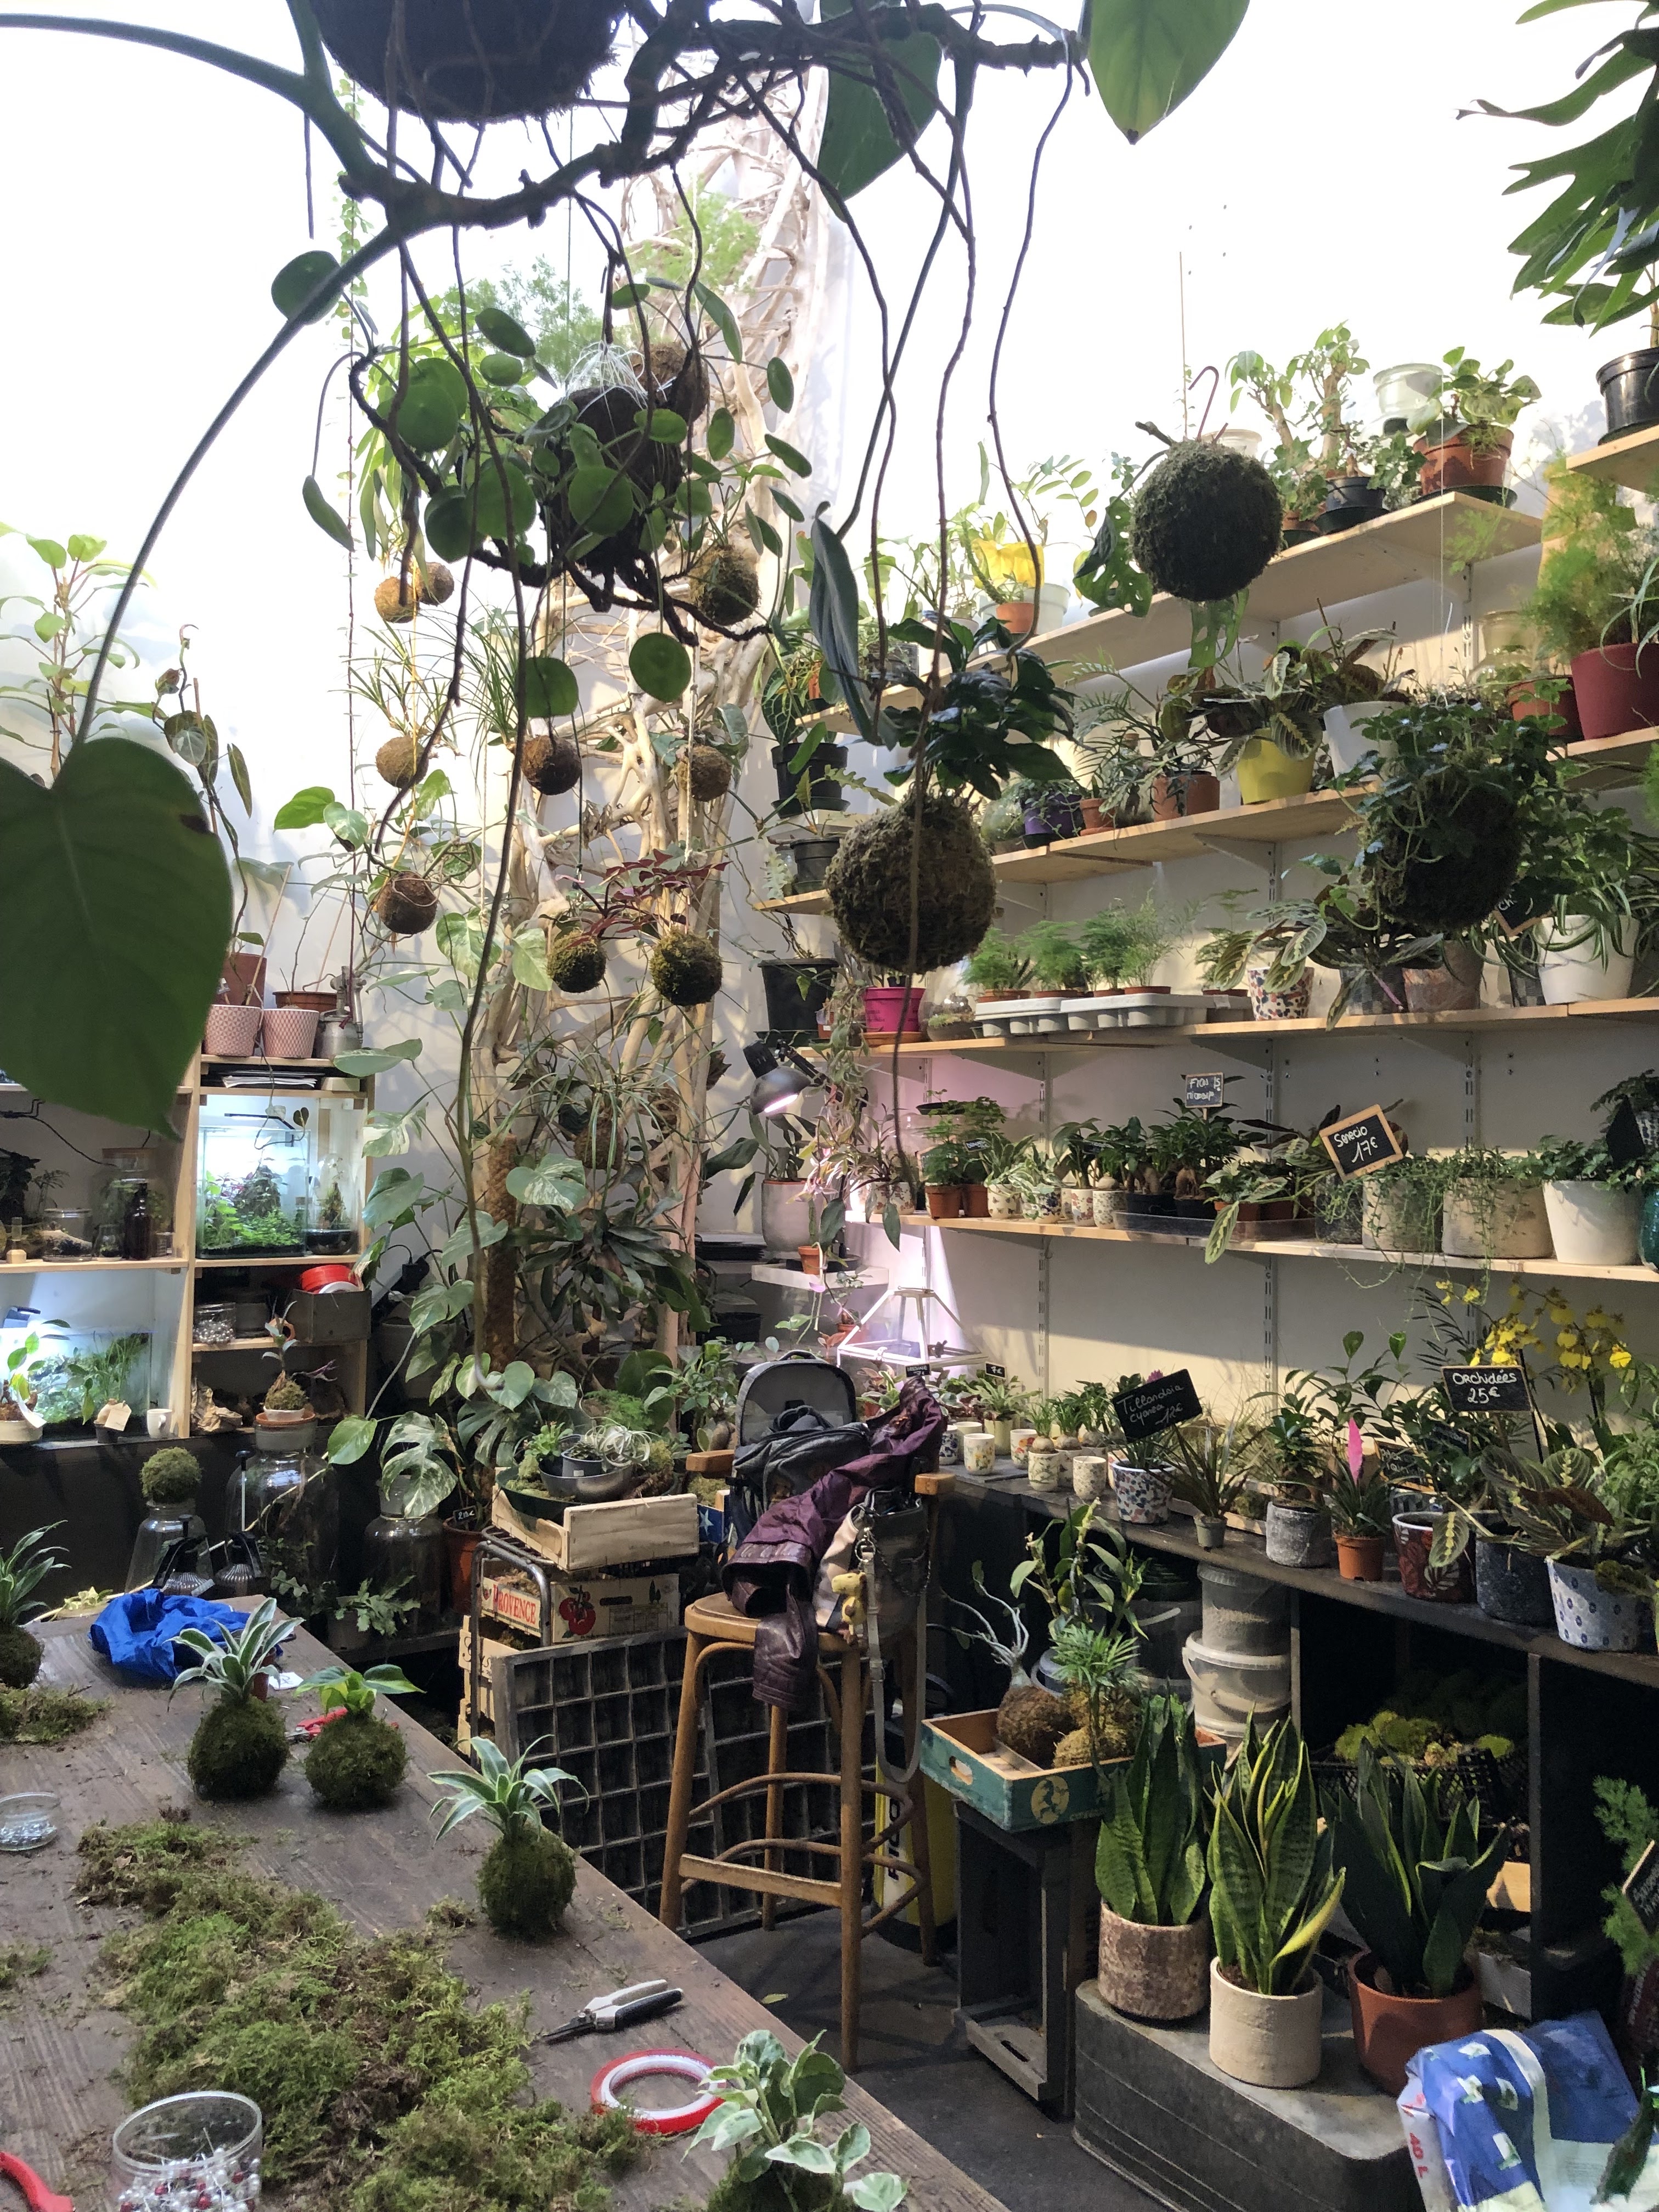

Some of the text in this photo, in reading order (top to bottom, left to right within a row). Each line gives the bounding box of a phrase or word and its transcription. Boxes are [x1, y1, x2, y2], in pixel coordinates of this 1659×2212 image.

[1334, 1126, 1368, 1148] Senecio
[1351, 1136, 1378, 1163] 17€
[1116, 1384, 1184, 1415] Tillandsia
[1467, 1386, 1501, 1404] 25€
